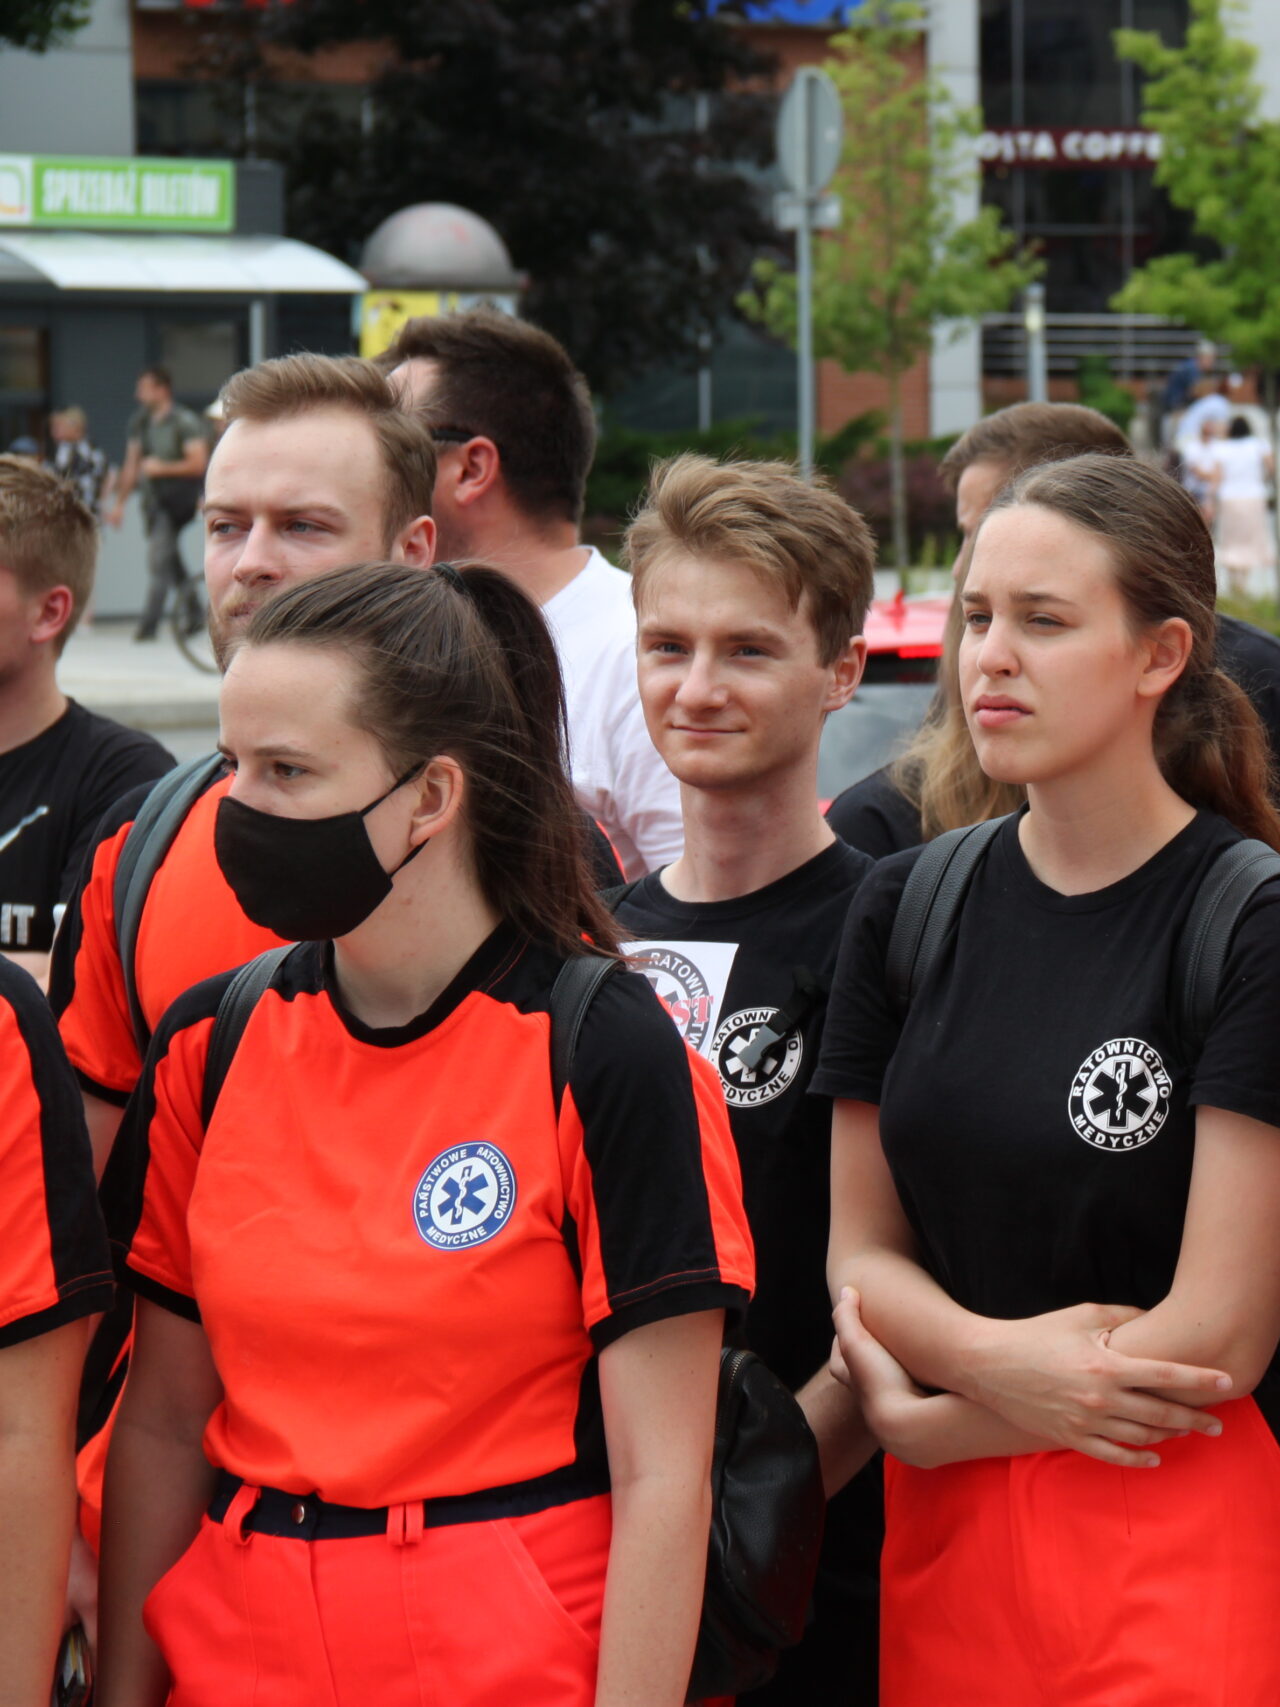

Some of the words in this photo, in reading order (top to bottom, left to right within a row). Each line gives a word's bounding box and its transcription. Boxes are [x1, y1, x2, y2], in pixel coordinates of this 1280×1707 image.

[1072, 1041, 1170, 1099] RATOWNICTWO
[1074, 1110, 1165, 1149] MEDYCZNE
[418, 1148, 468, 1219] PAŃSTWOWE
[476, 1146, 511, 1220] RATOWNICTWO
[426, 1225, 488, 1246] MEDYCZNE
